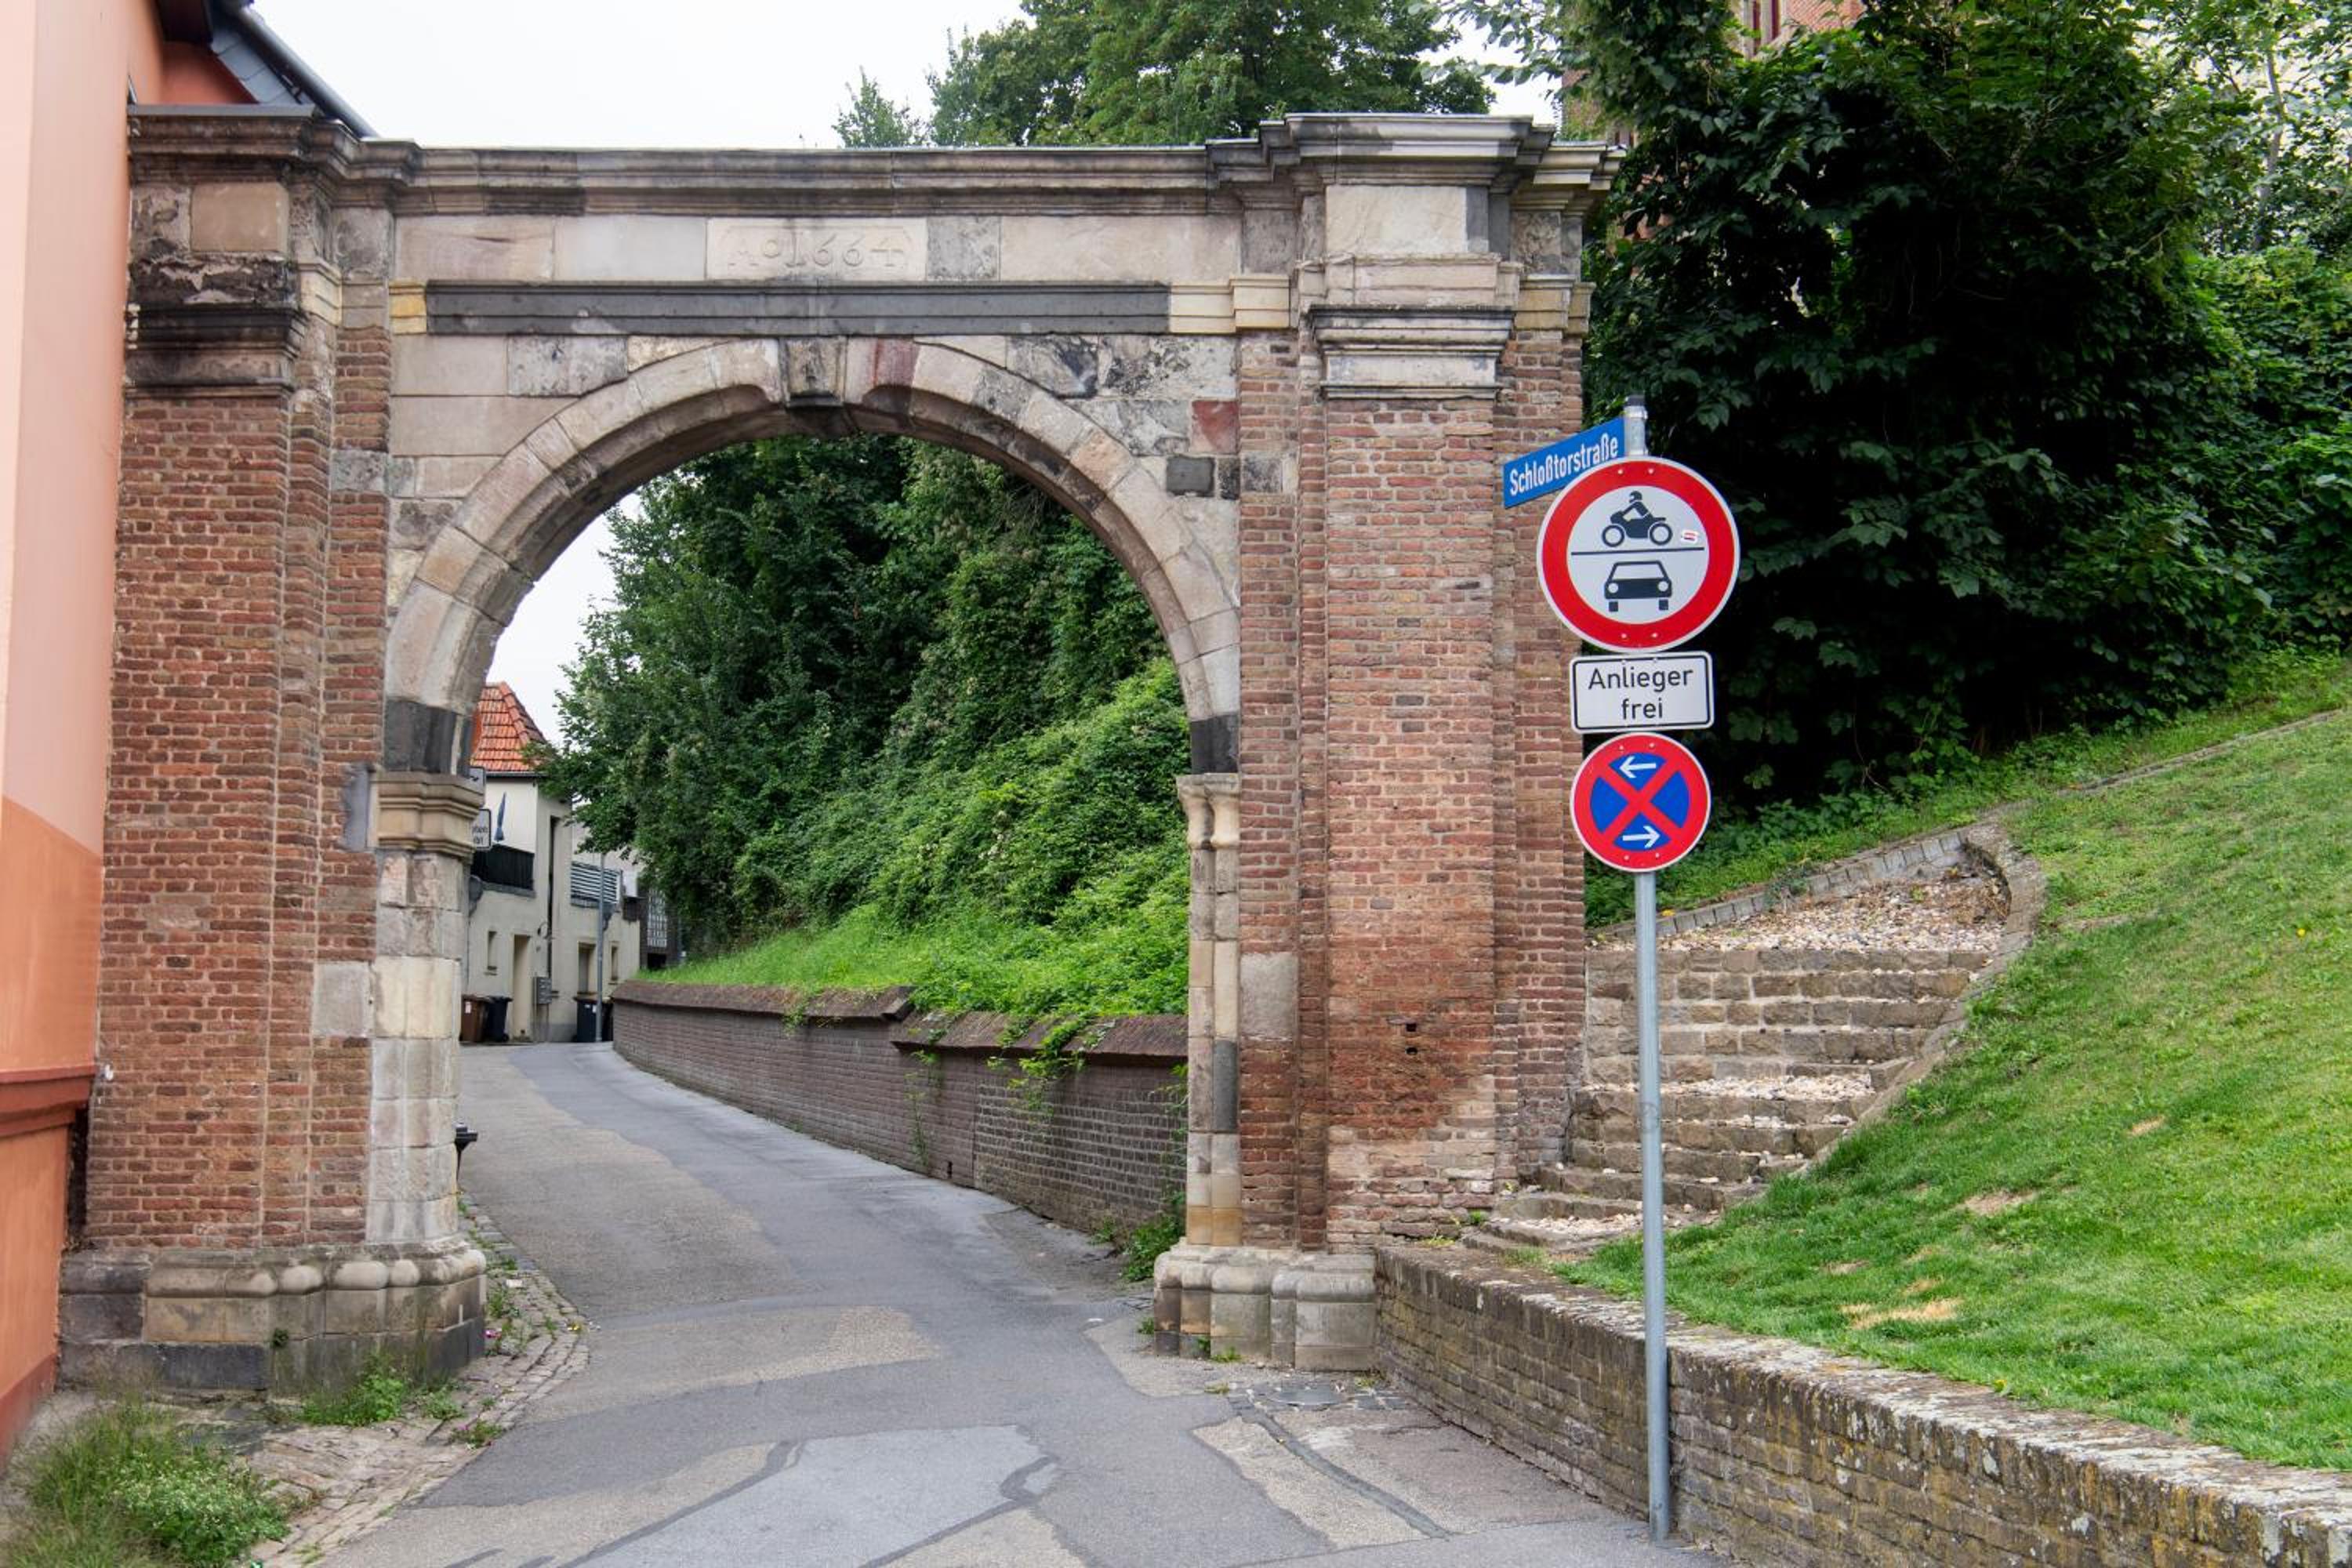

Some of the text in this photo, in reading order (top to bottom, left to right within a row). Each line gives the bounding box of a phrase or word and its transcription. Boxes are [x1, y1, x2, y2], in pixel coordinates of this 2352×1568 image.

[1509, 432, 1618, 496] Schloßtorstraße
[1588, 666, 1693, 692] Anlieger
[1621, 697, 1663, 720] frei
